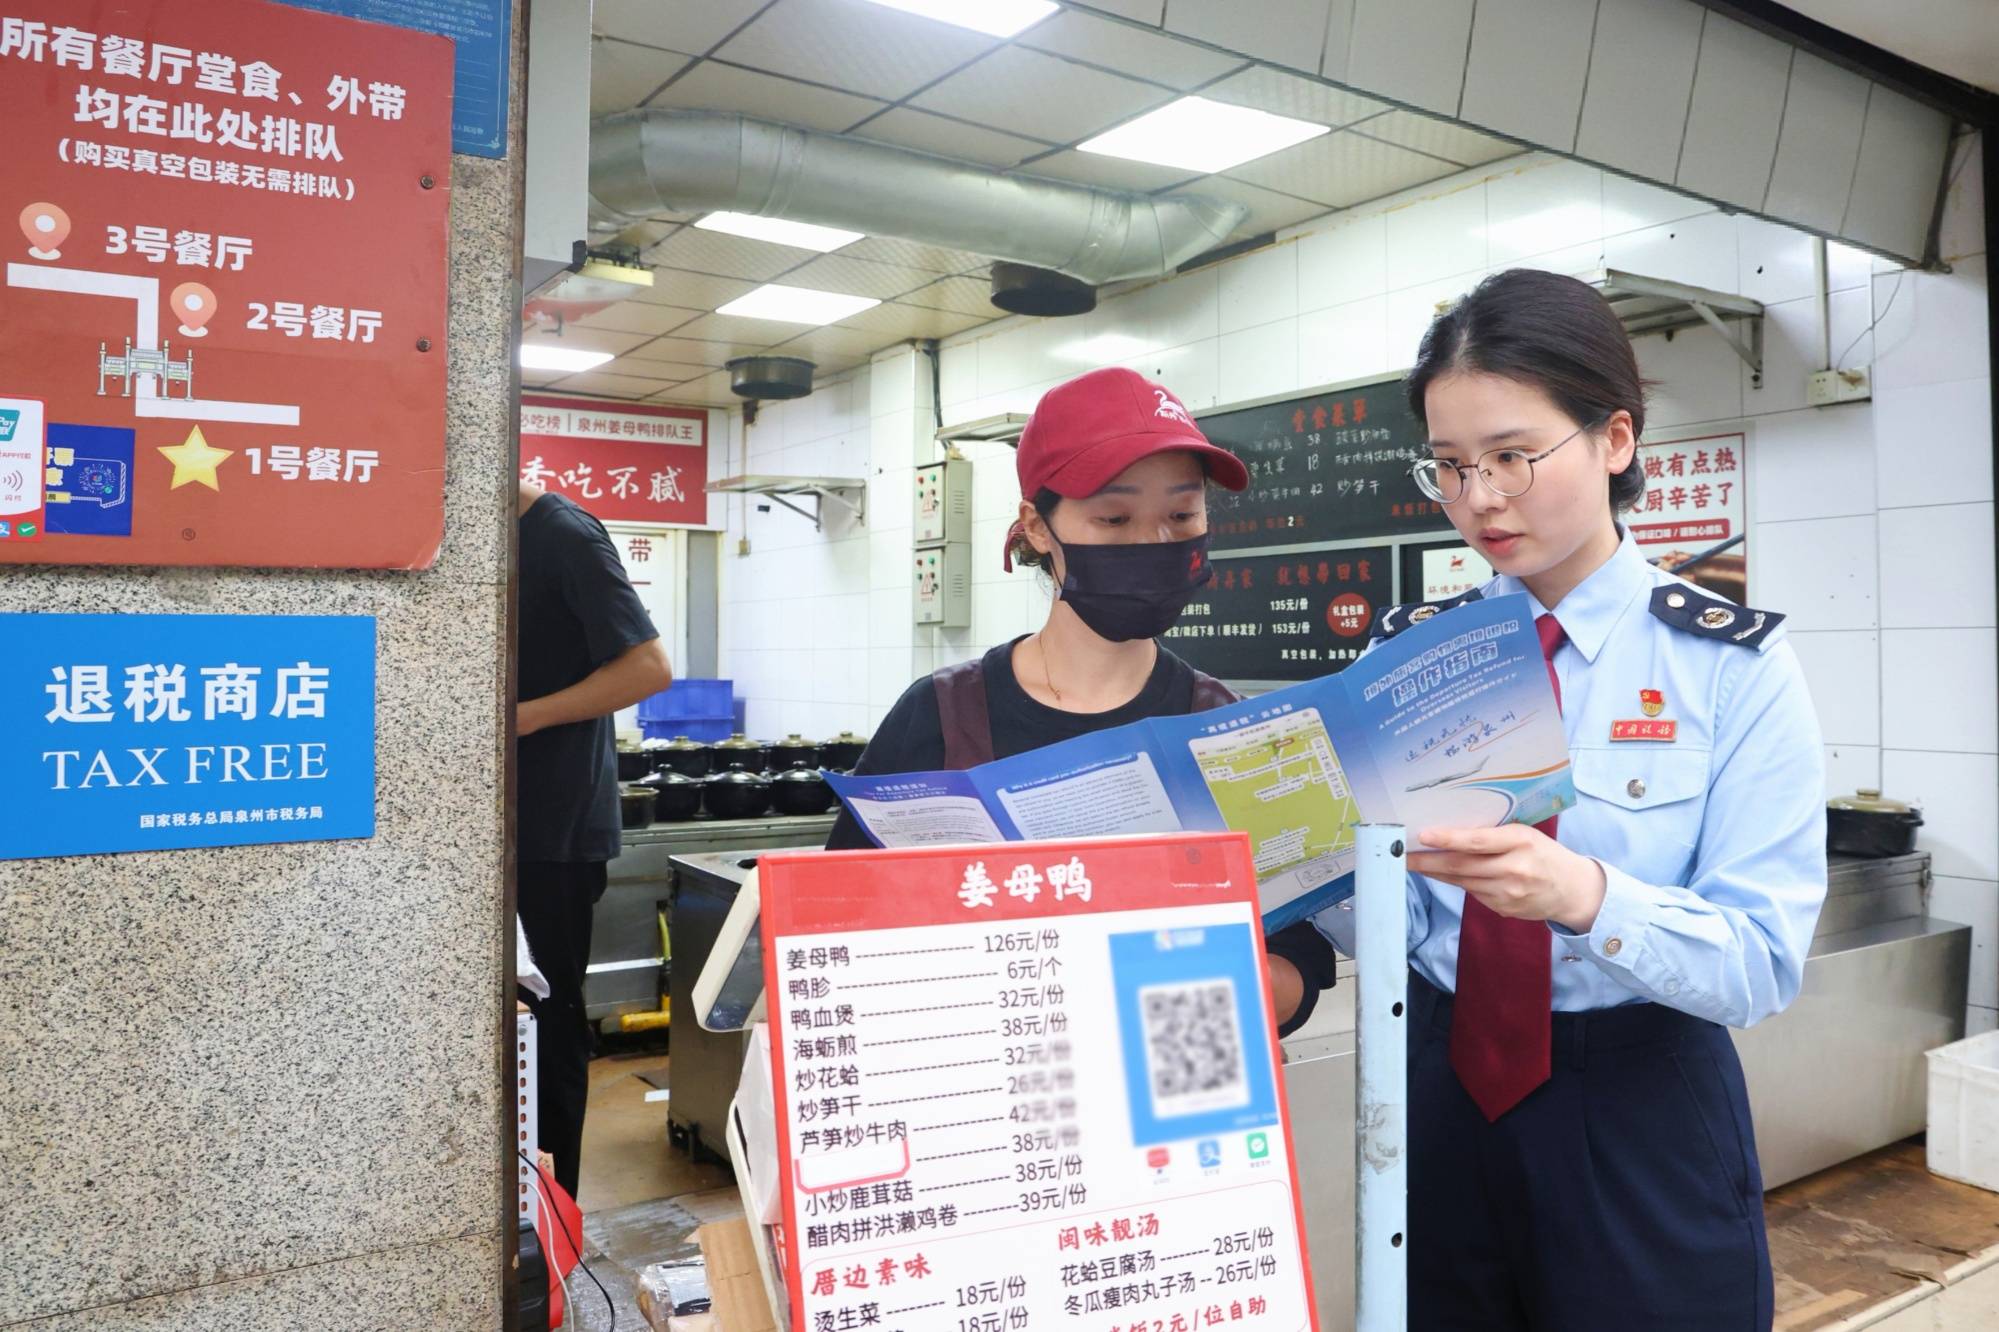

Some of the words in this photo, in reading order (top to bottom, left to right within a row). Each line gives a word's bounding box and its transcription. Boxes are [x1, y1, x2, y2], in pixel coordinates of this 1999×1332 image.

[0, 18, 406, 121] 所有餐厅堂食、外带
[74, 85, 344, 162] 均在此处排队
[105, 226, 253, 271] 3号餐厅
[246, 302, 383, 343] 2号餐厅
[578, 417, 693, 440] 泉州姜母鸭排队王
[245, 446, 379, 483] 1号餐厅
[1308, 454, 1319, 471] 18
[1636, 447, 1737, 479] 做有点热
[1310, 483, 1323, 496] 42
[1631, 482, 1733, 513] 厨辛苦了
[628, 538, 652, 562] 带
[1270, 598, 1308, 612] 135元/份
[1272, 622, 1311, 635] 153元/份
[45, 662, 330, 723] 退税商店
[42, 748, 169, 790] TAX
[184, 743, 328, 784] FREE
[140, 806, 323, 828] 国家税务总局泉州市税务局
[958, 857, 1092, 908] 姜母鸭
[787, 945, 850, 970] 姜母鸭
[985, 929, 1059, 952] 126元/份
[789, 976, 831, 1000] 鸭胗
[1008, 956, 1062, 980] 6元/个
[791, 1004, 854, 1030] 鸭血煲
[999, 984, 1064, 1008] 32元/份
[793, 1034, 857, 1061] 海蛎煎
[1002, 1012, 1067, 1037] 38元/份
[796, 1064, 859, 1092] 炒花蛤
[797, 1094, 862, 1123] 炒笋干
[800, 1119, 907, 1154] 芦笋炒牛肉
[805, 1180, 913, 1217] 小炒鹿茸菇
[1015, 1154, 1083, 1185] 38元/份
[807, 1204, 958, 1249] 醋肉拼洪濑鸡卷
[1019, 1183, 1087, 1214] 39元/份
[1058, 1213, 1160, 1251] 闽味靓汤
[1060, 1250, 1156, 1288] 花蛤豆腐汤
[1213, 1226, 1274, 1256] 28元/份
[814, 1302, 881, 1332] 烫生菜
[956, 1275, 1026, 1308] 18元/份
[1064, 1272, 1196, 1316] 冬瓜瘦肉丸子汤
[1215, 1255, 1276, 1285] 26元/份
